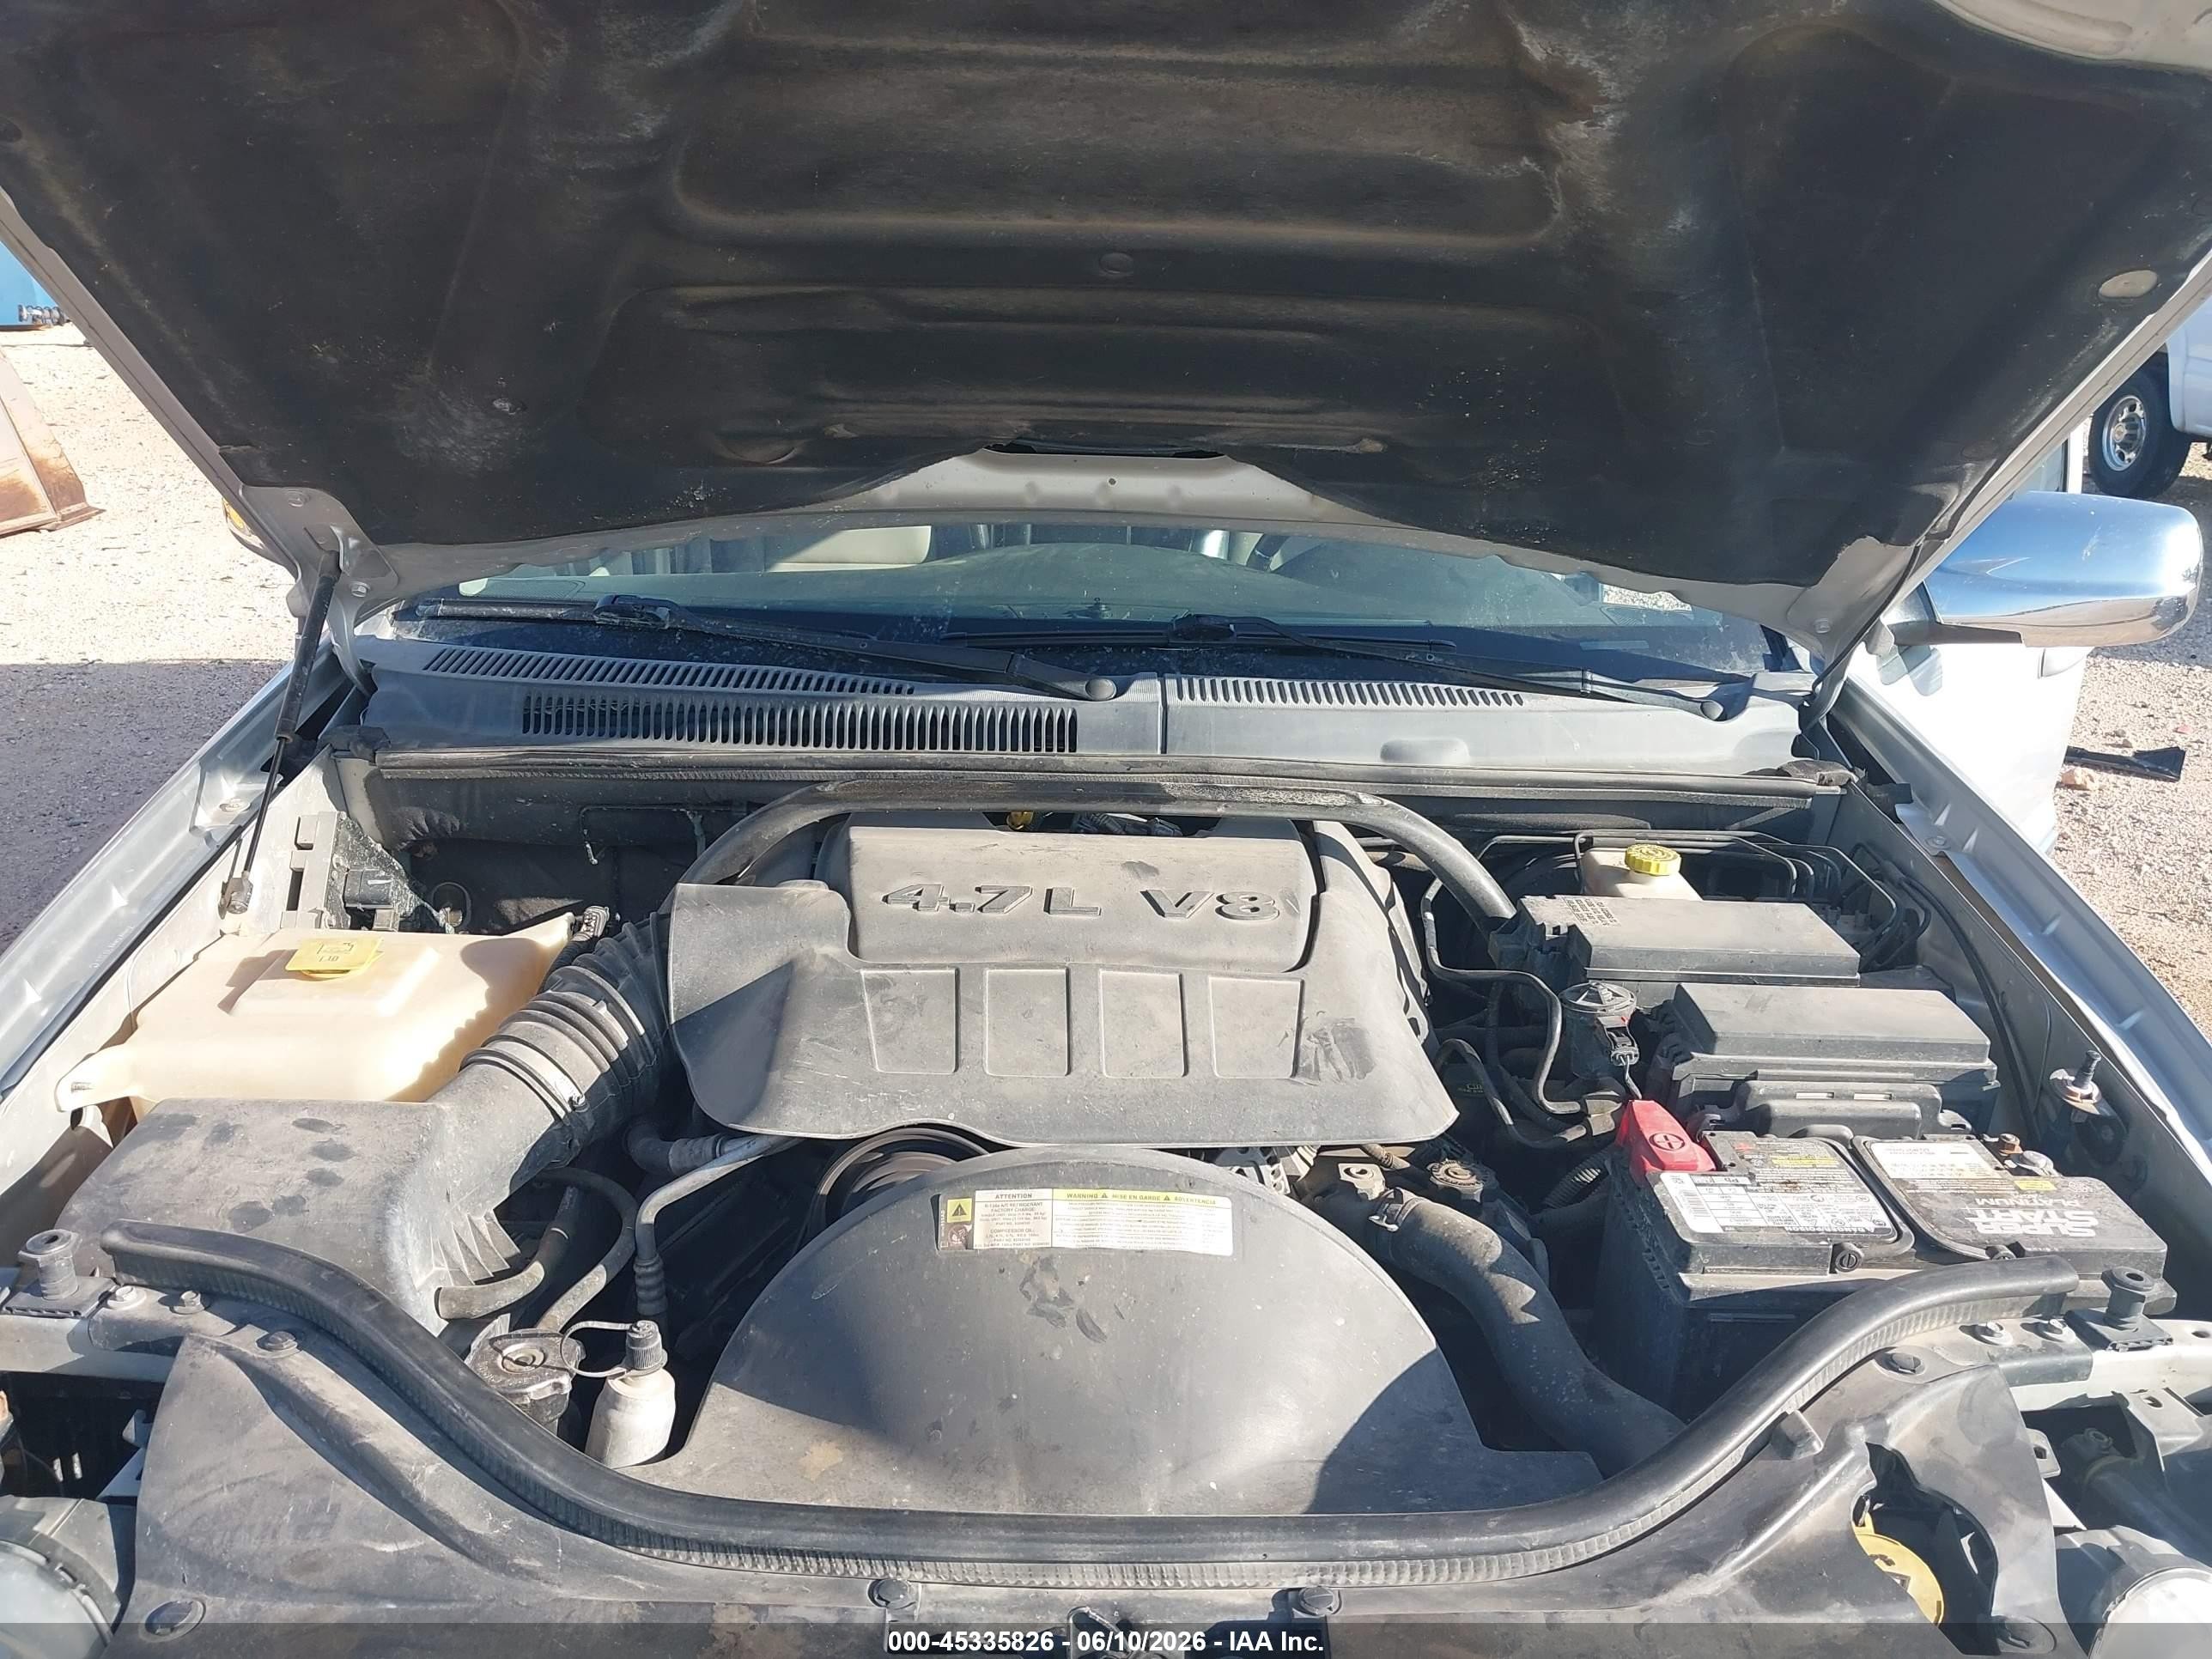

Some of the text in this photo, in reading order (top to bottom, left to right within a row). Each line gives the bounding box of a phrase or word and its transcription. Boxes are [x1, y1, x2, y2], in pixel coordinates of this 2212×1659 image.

[881, 883, 1279, 921] 4.7L V8
[1975, 1198, 2081, 1207] PLATINUM
[1965, 1210, 2099, 1226] START
[1975, 1221, 2097, 1237] SUPER
